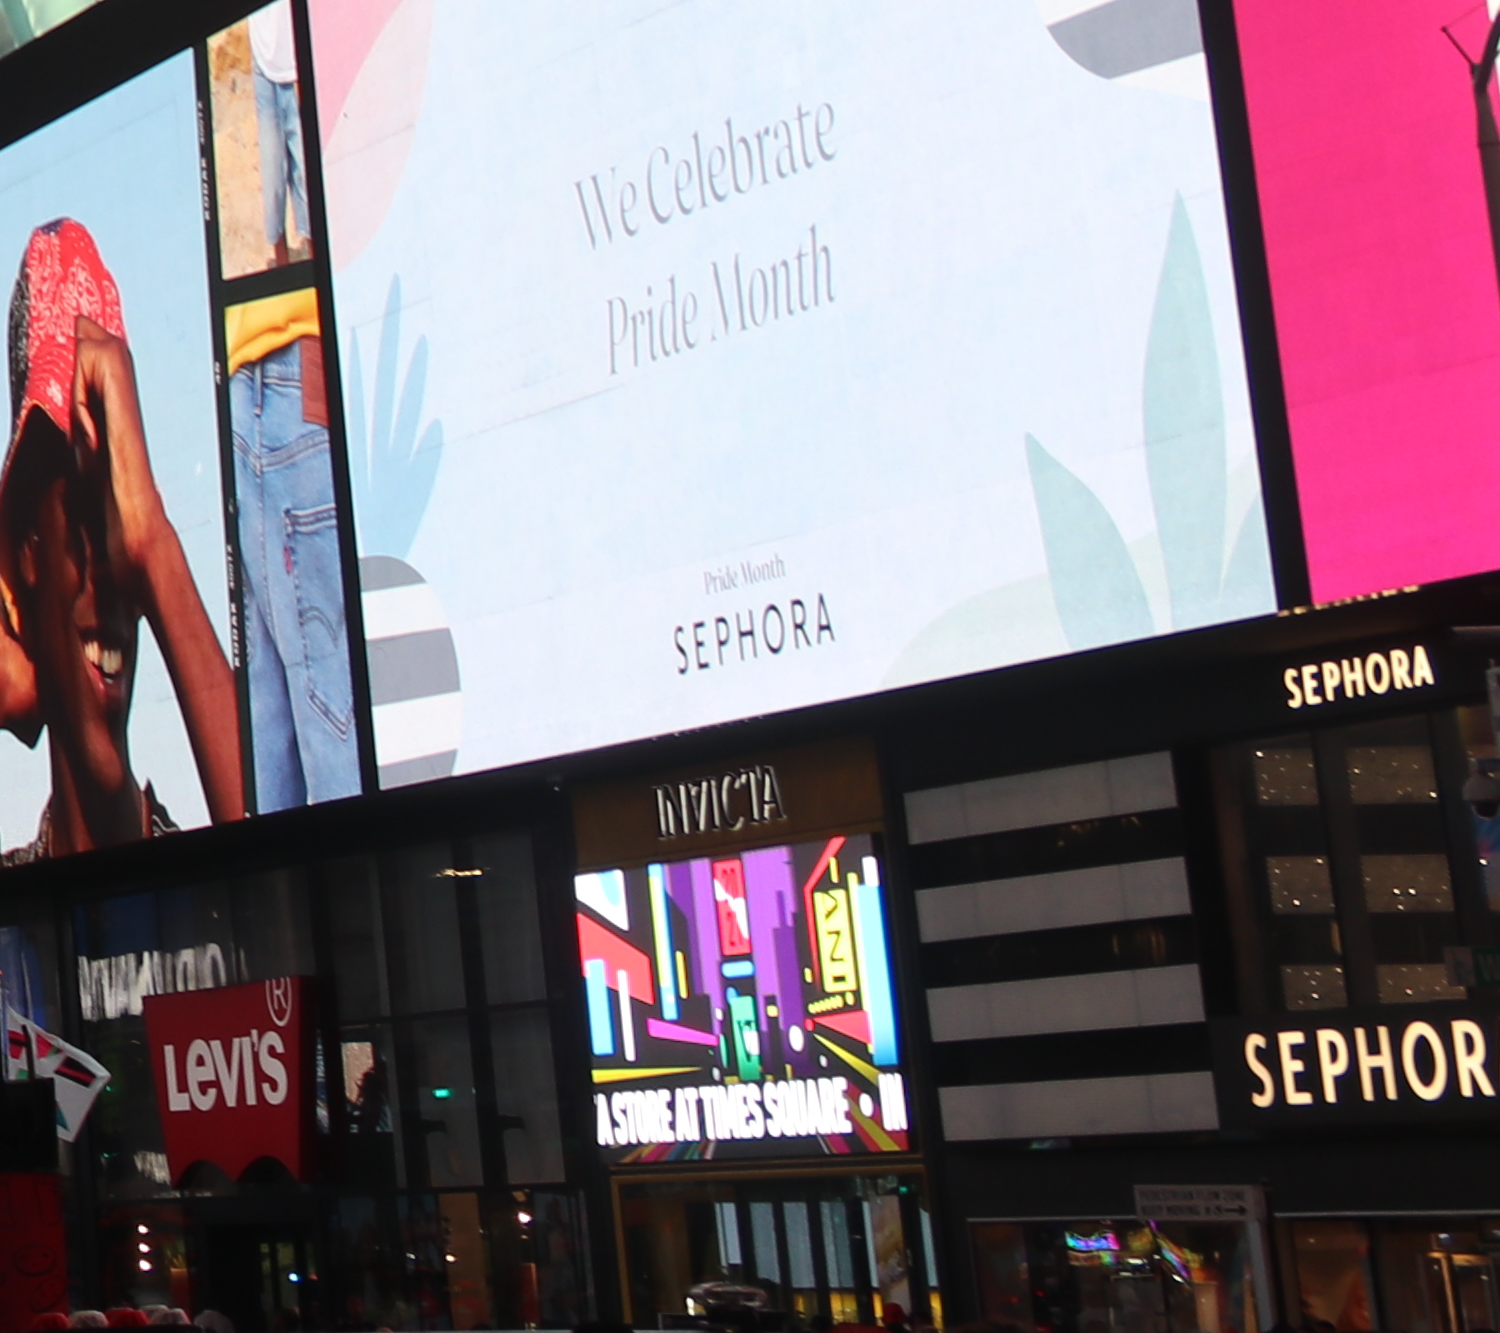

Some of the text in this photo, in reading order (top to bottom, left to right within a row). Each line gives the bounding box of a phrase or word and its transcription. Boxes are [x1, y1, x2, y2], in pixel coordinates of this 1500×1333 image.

[573, 100, 840, 251] We Celebrate
[604, 220, 838, 378] Pride Month
[703, 551, 787, 597] Pride Month
[673, 592, 838, 677] SEPHORA
[1283, 645, 1435, 710] SEPHORA
[652, 765, 788, 841] INVICTA
[611, 1088, 675, 1145] STORE
[674, 1086, 702, 1142] AT
[700, 1081, 765, 1142] TIMES
[763, 1075, 853, 1138] SQUARE
